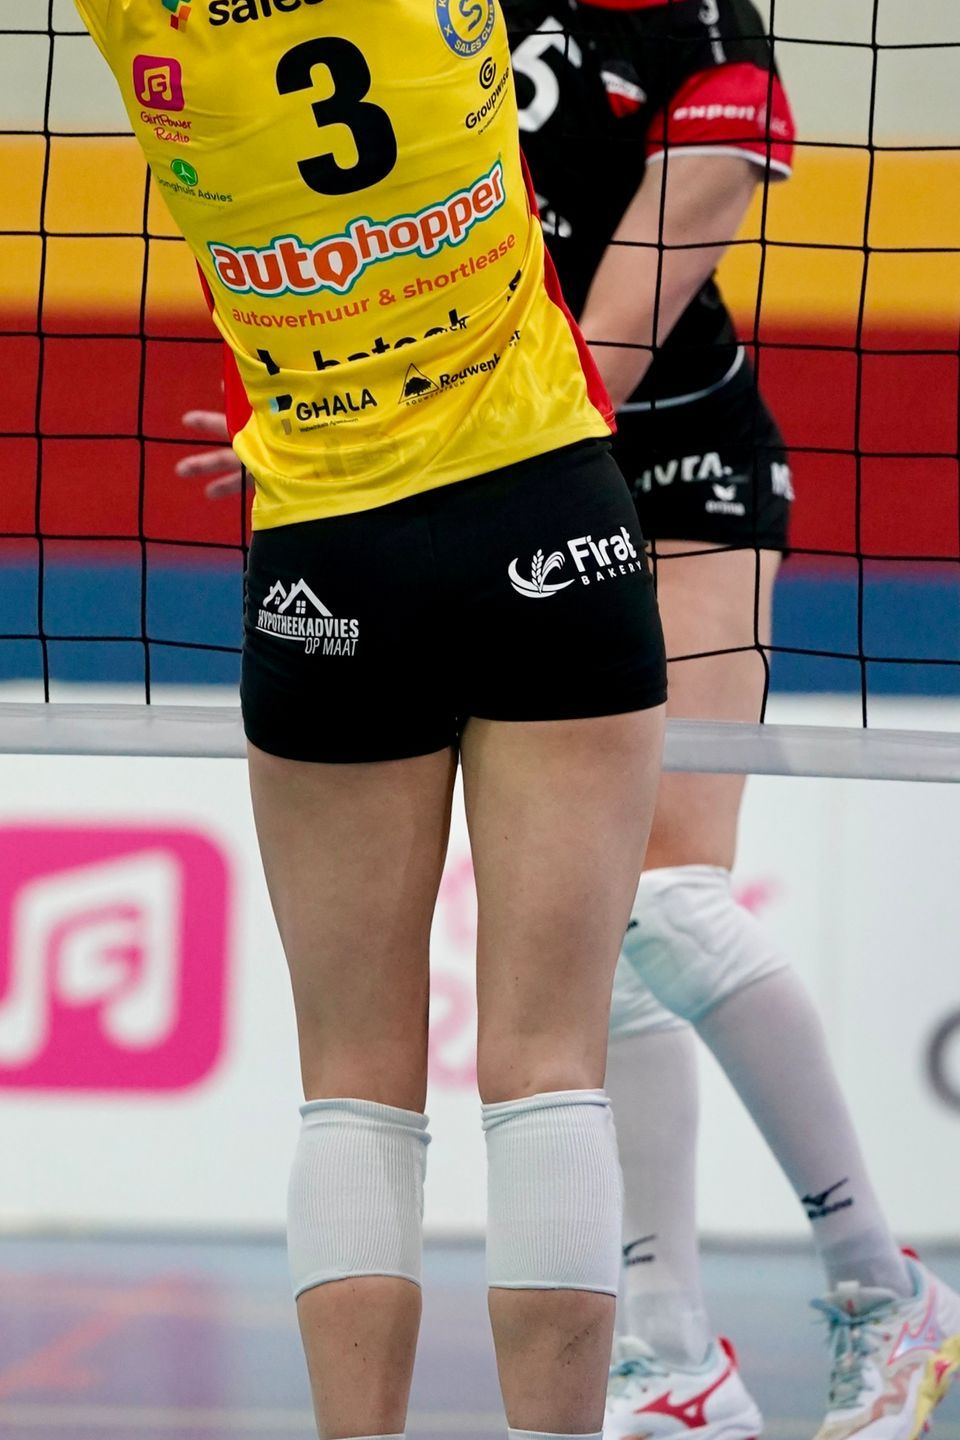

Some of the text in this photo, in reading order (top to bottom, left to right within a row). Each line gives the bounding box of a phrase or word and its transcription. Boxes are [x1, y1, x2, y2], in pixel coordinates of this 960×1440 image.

[455, 39, 482, 54] SALES
[276, 35, 398, 196] 3
[154, 127, 190, 143] Radio
[198, 188, 233, 203] Advies
[211, 163, 504, 294] autohopper
[232, 233, 516, 328] autoverhuur & shortlease
[296, 388, 377, 423] GHALA
[567, 526, 637, 572] Firat
[580, 561, 642, 586] BAKERY
[257, 609, 360, 638] HYPOTHEEKADVIES
[304, 637, 359, 656] OP MAAT
